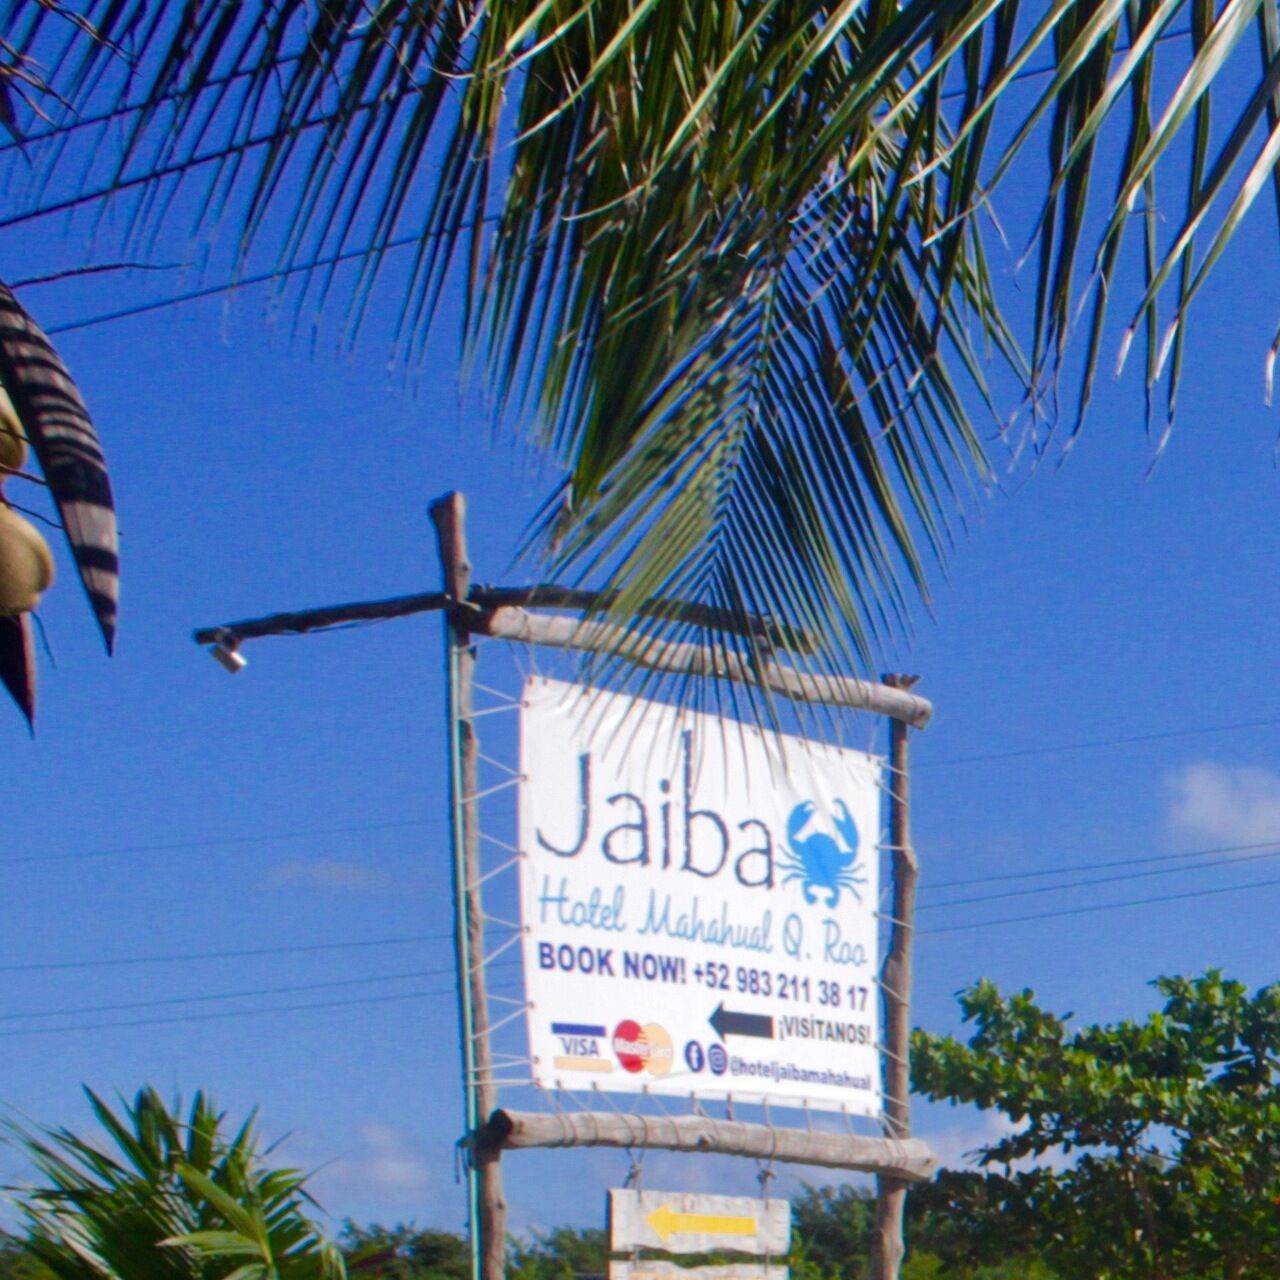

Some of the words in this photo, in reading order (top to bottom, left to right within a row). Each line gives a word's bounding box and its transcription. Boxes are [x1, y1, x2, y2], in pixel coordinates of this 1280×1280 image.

[536, 730, 774, 889] Jaiba
[538, 874, 627, 932] Hotel
[637, 888, 773, 953] Mahahual
[782, 912, 811, 962] Q.
[823, 918, 868, 966] Roo
[538, 941, 616, 977] BOOK
[623, 950, 687, 984] NOW!
[693, 961, 731, 991] +52
[736, 966, 772, 997] 983
[777, 973, 811, 1003] 211
[818, 979, 841, 1007] 38
[848, 985, 868, 1012] 17
[559, 1036, 600, 1057] VISA
